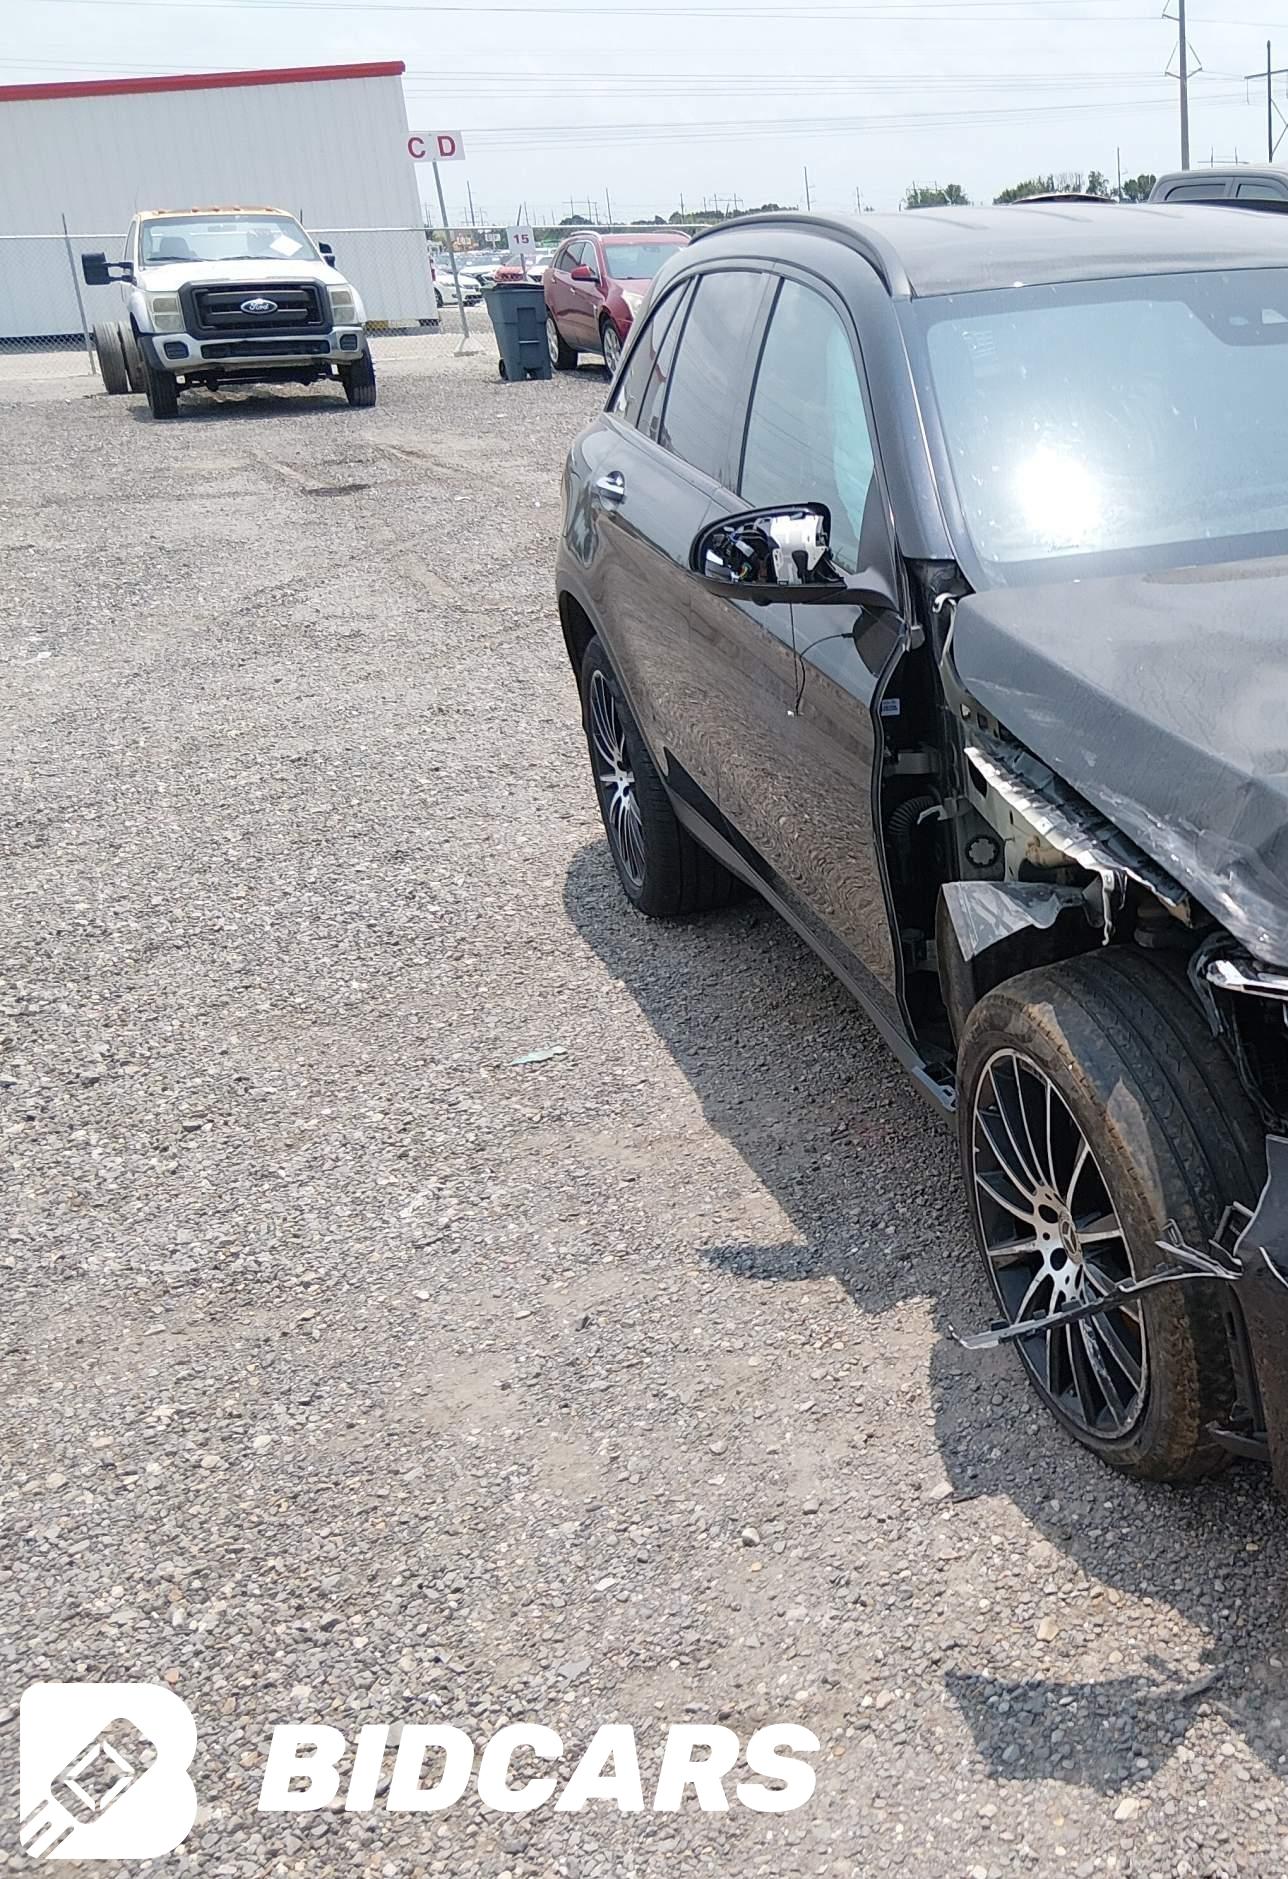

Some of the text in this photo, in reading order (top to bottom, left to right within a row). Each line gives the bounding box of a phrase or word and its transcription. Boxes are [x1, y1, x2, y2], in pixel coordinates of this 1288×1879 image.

[408, 136, 456, 158] C D
[513, 233, 529, 244] 15
